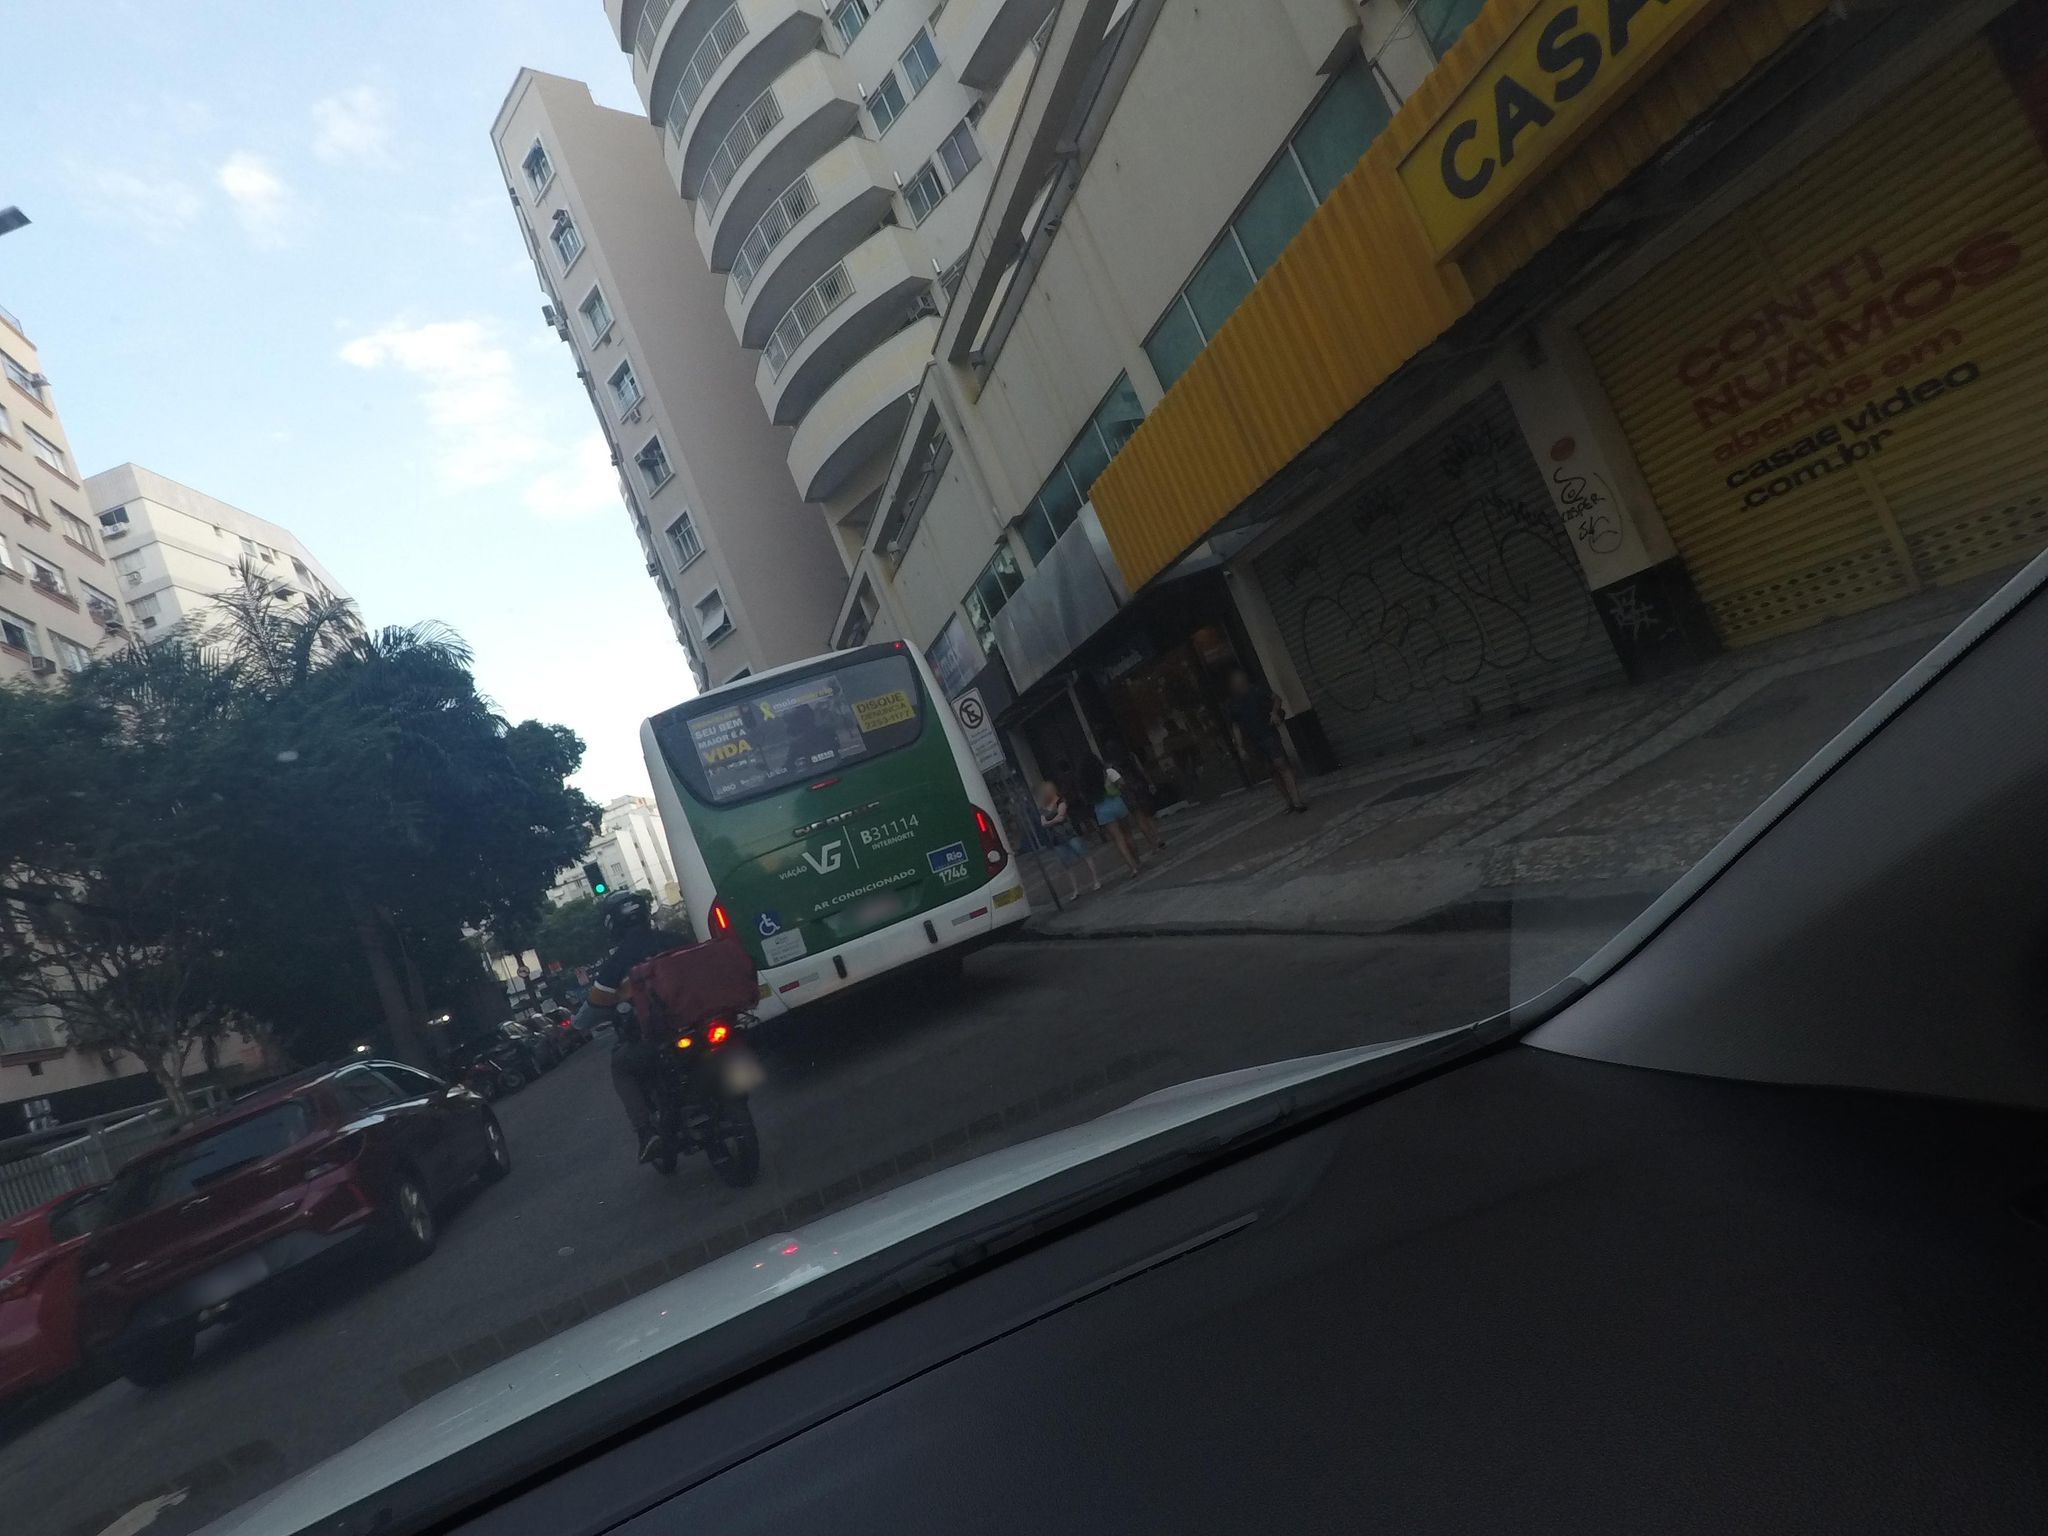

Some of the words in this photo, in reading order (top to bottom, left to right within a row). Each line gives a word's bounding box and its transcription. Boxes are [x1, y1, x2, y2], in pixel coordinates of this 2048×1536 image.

[1678, 247, 1883, 386] CONTI
[1692, 230, 2021, 431] NUAMOS
[1712, 372, 1872, 463] abertos
[1881, 327, 1963, 379] em
[856, 692, 905, 713] DISQUE
[703, 738, 753, 765] VIDA
[859, 813, 920, 845] B31114
[871, 830, 916, 850] INTERNORTE
[938, 863, 968, 883] 1746
[813, 901, 831, 912] AR
[830, 868, 916, 907] CONDICIONADO
